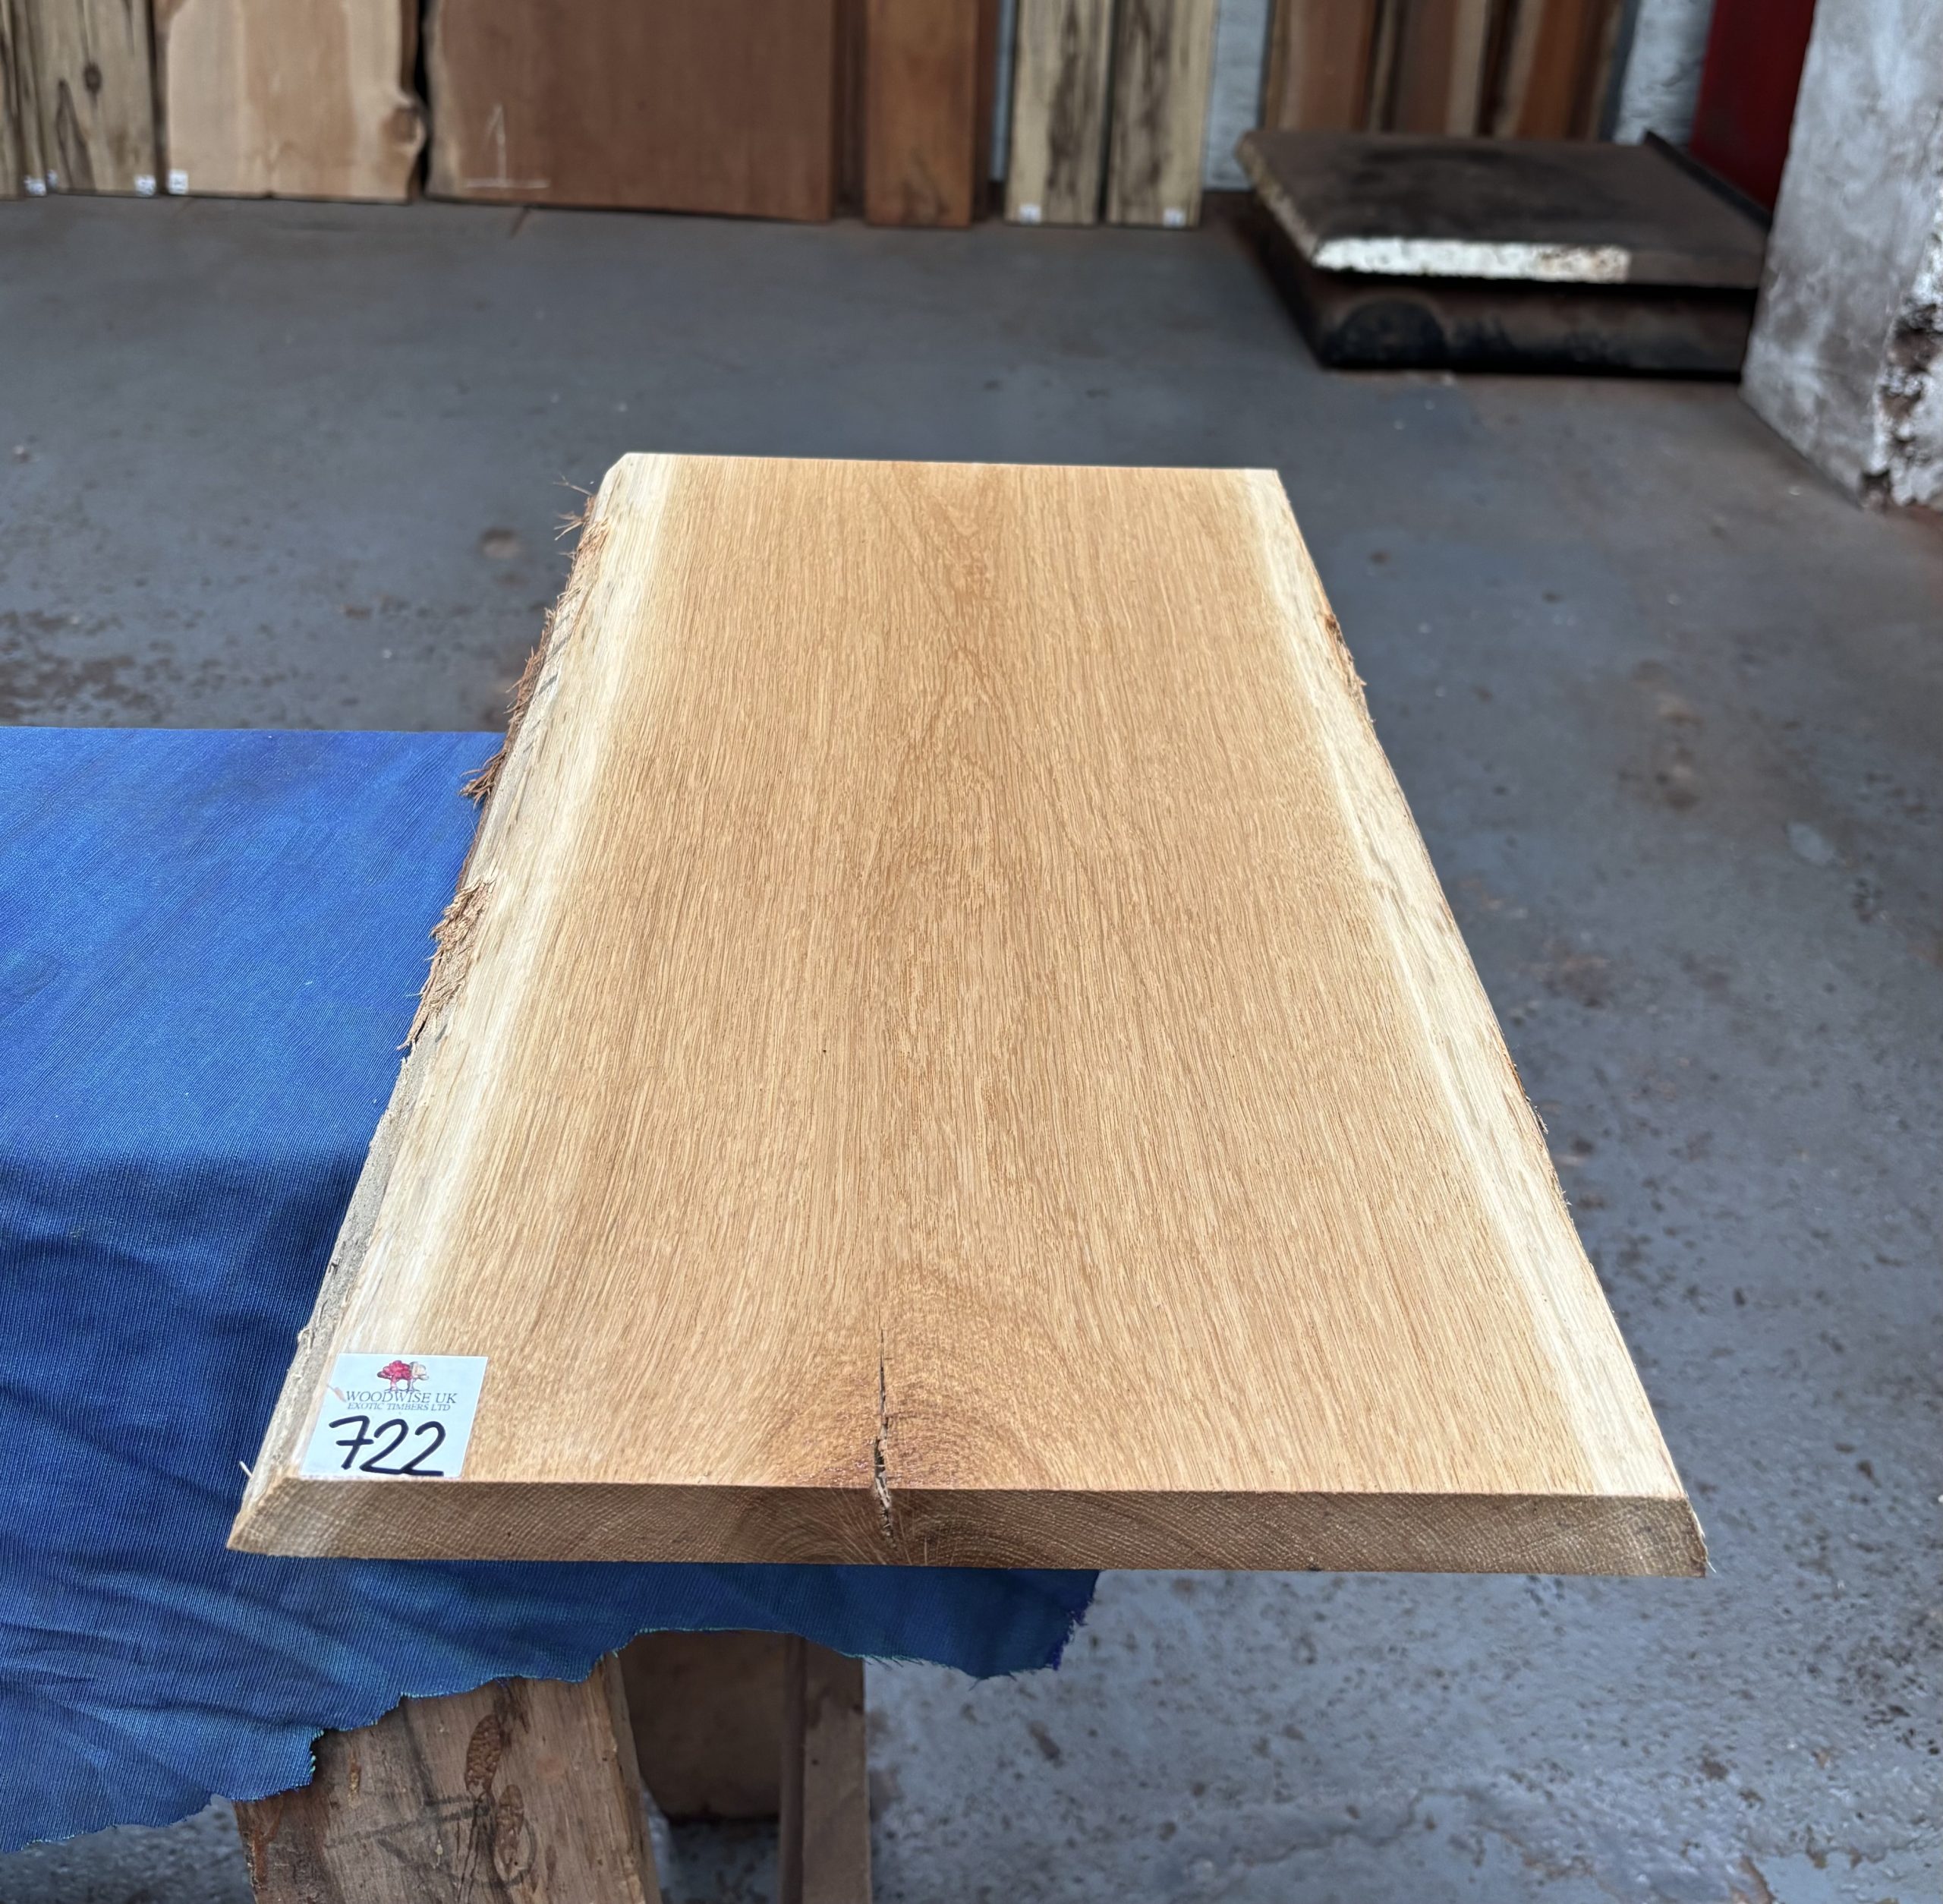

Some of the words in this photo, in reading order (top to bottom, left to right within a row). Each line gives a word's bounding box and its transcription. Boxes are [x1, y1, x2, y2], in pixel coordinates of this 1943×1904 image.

[345, 1391, 431, 1404] WOODWISE
[436, 1392, 458, 1404] UK
[347, 1402, 383, 1411] EXOTIC
[387, 1403, 429, 1411] TIMBERS
[329, 1415, 446, 1477] 722
